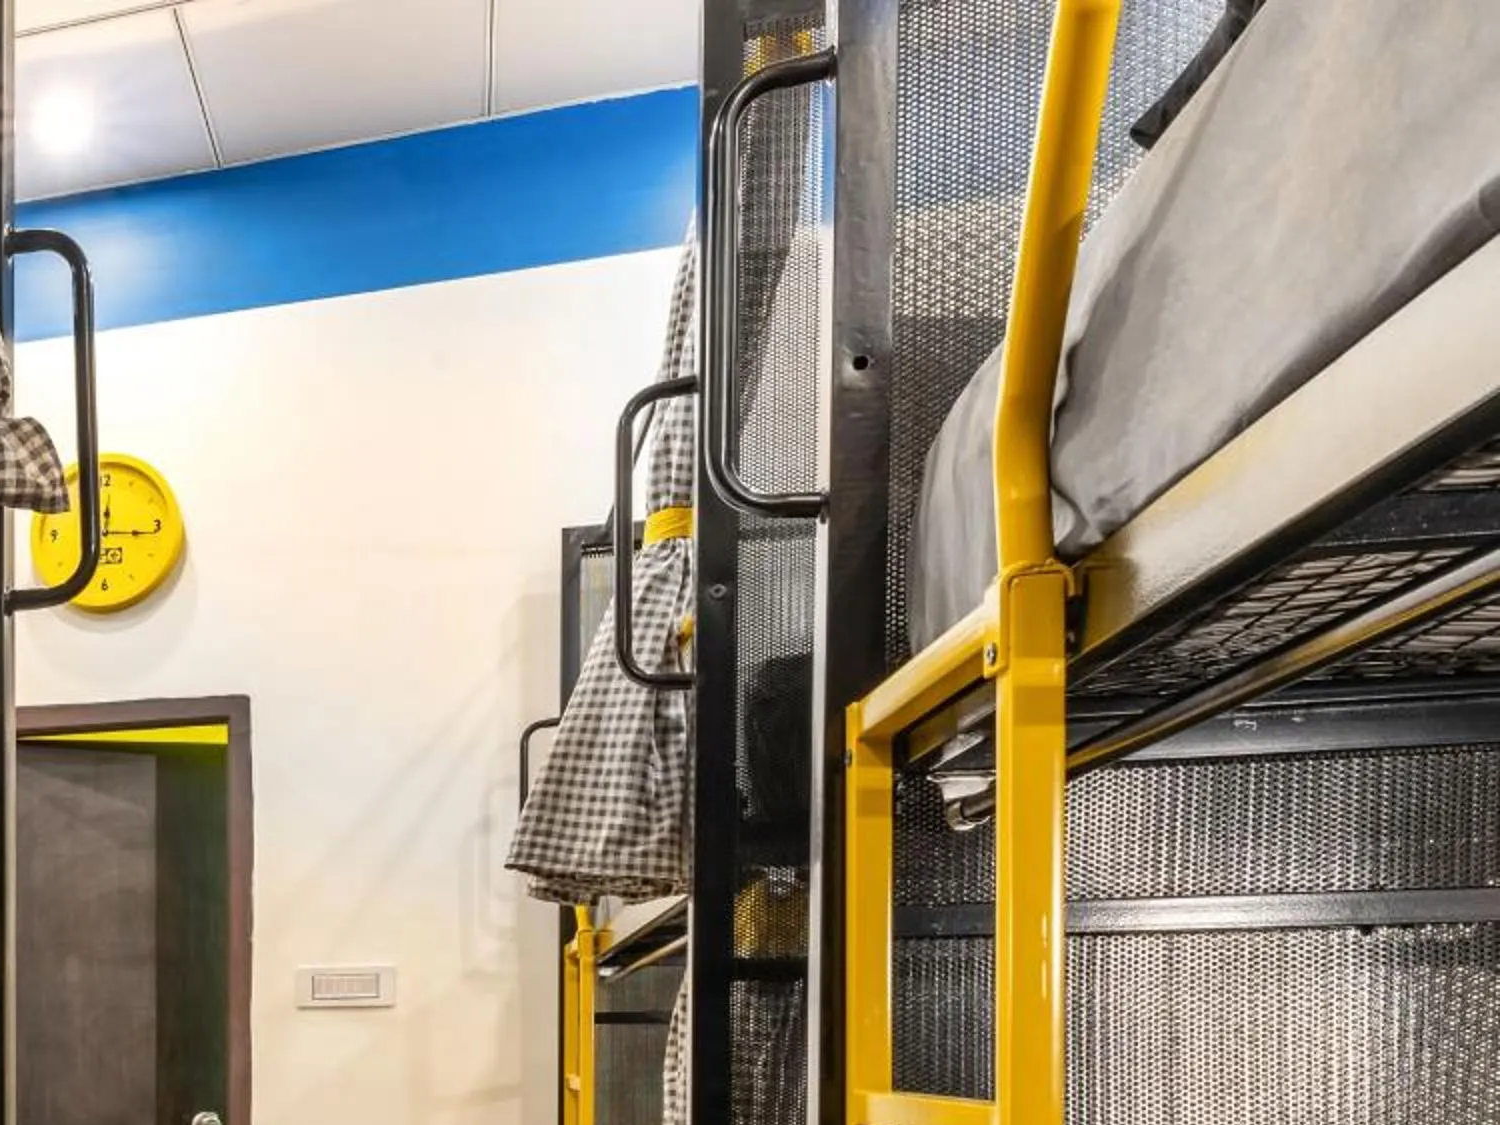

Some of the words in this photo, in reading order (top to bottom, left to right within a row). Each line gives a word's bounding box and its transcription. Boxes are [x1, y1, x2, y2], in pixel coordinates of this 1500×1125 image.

[153, 519, 162, 533] 3
[50, 529, 59, 543] 9
[101, 577, 109, 591] 6
